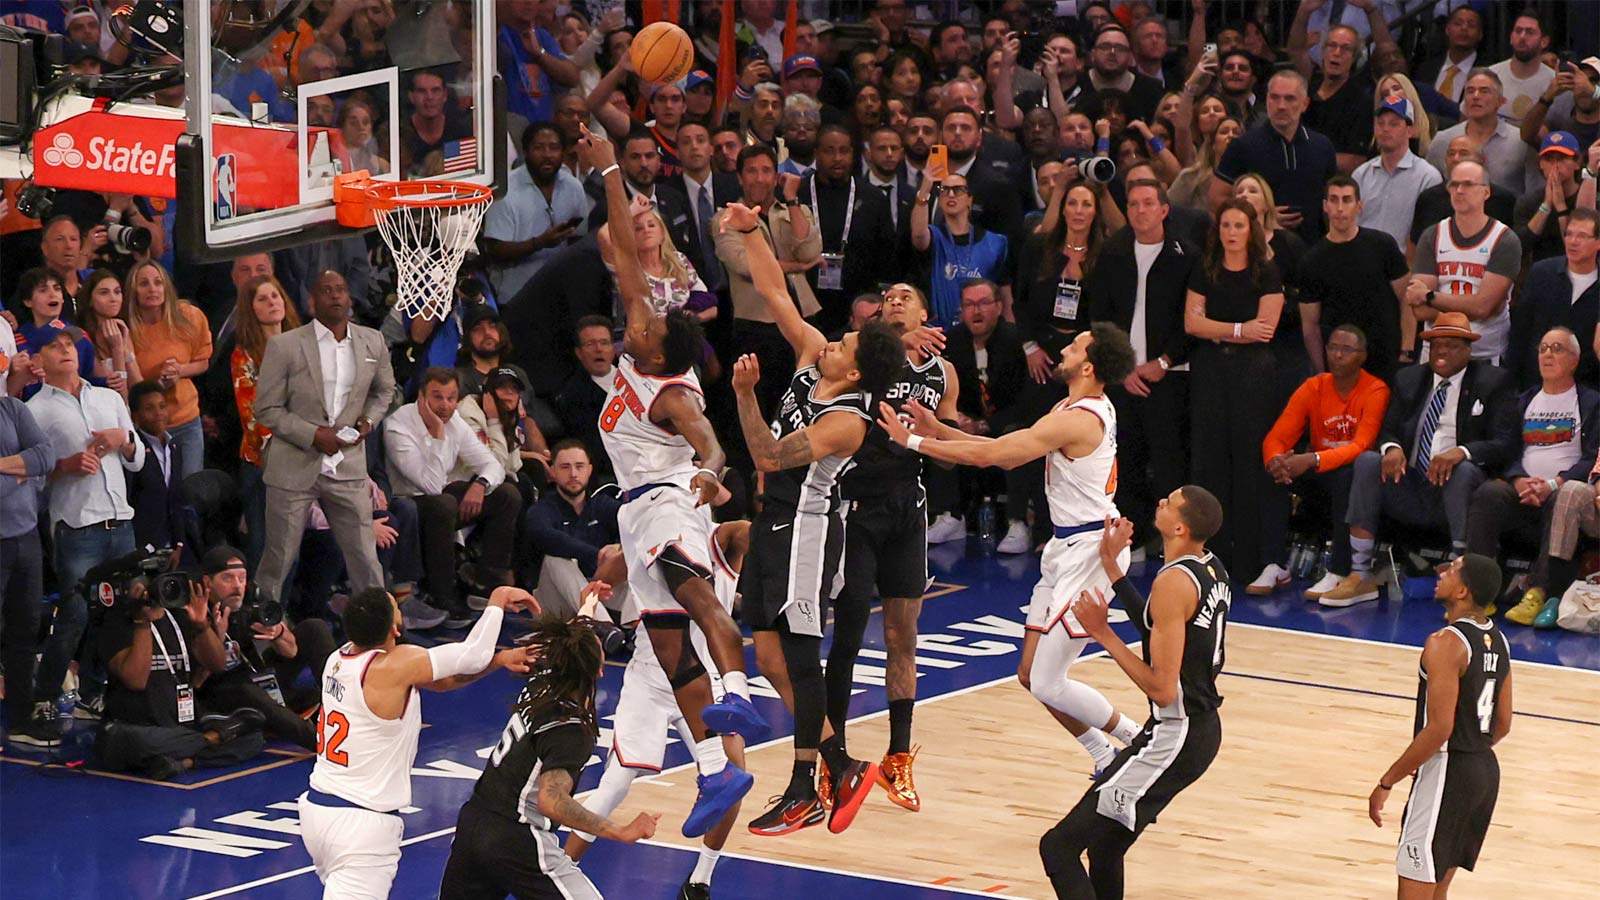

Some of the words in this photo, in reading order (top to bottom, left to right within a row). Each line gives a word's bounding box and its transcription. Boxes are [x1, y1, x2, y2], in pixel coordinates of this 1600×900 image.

[600, 395, 626, 433] 8
[885, 382, 942, 411] SPURS
[1212, 611, 1225, 667] 1
[1483, 652, 1499, 673] FOX
[324, 675, 346, 703] TOWNS
[1477, 678, 1497, 734] 4
[491, 712, 527, 768] 5
